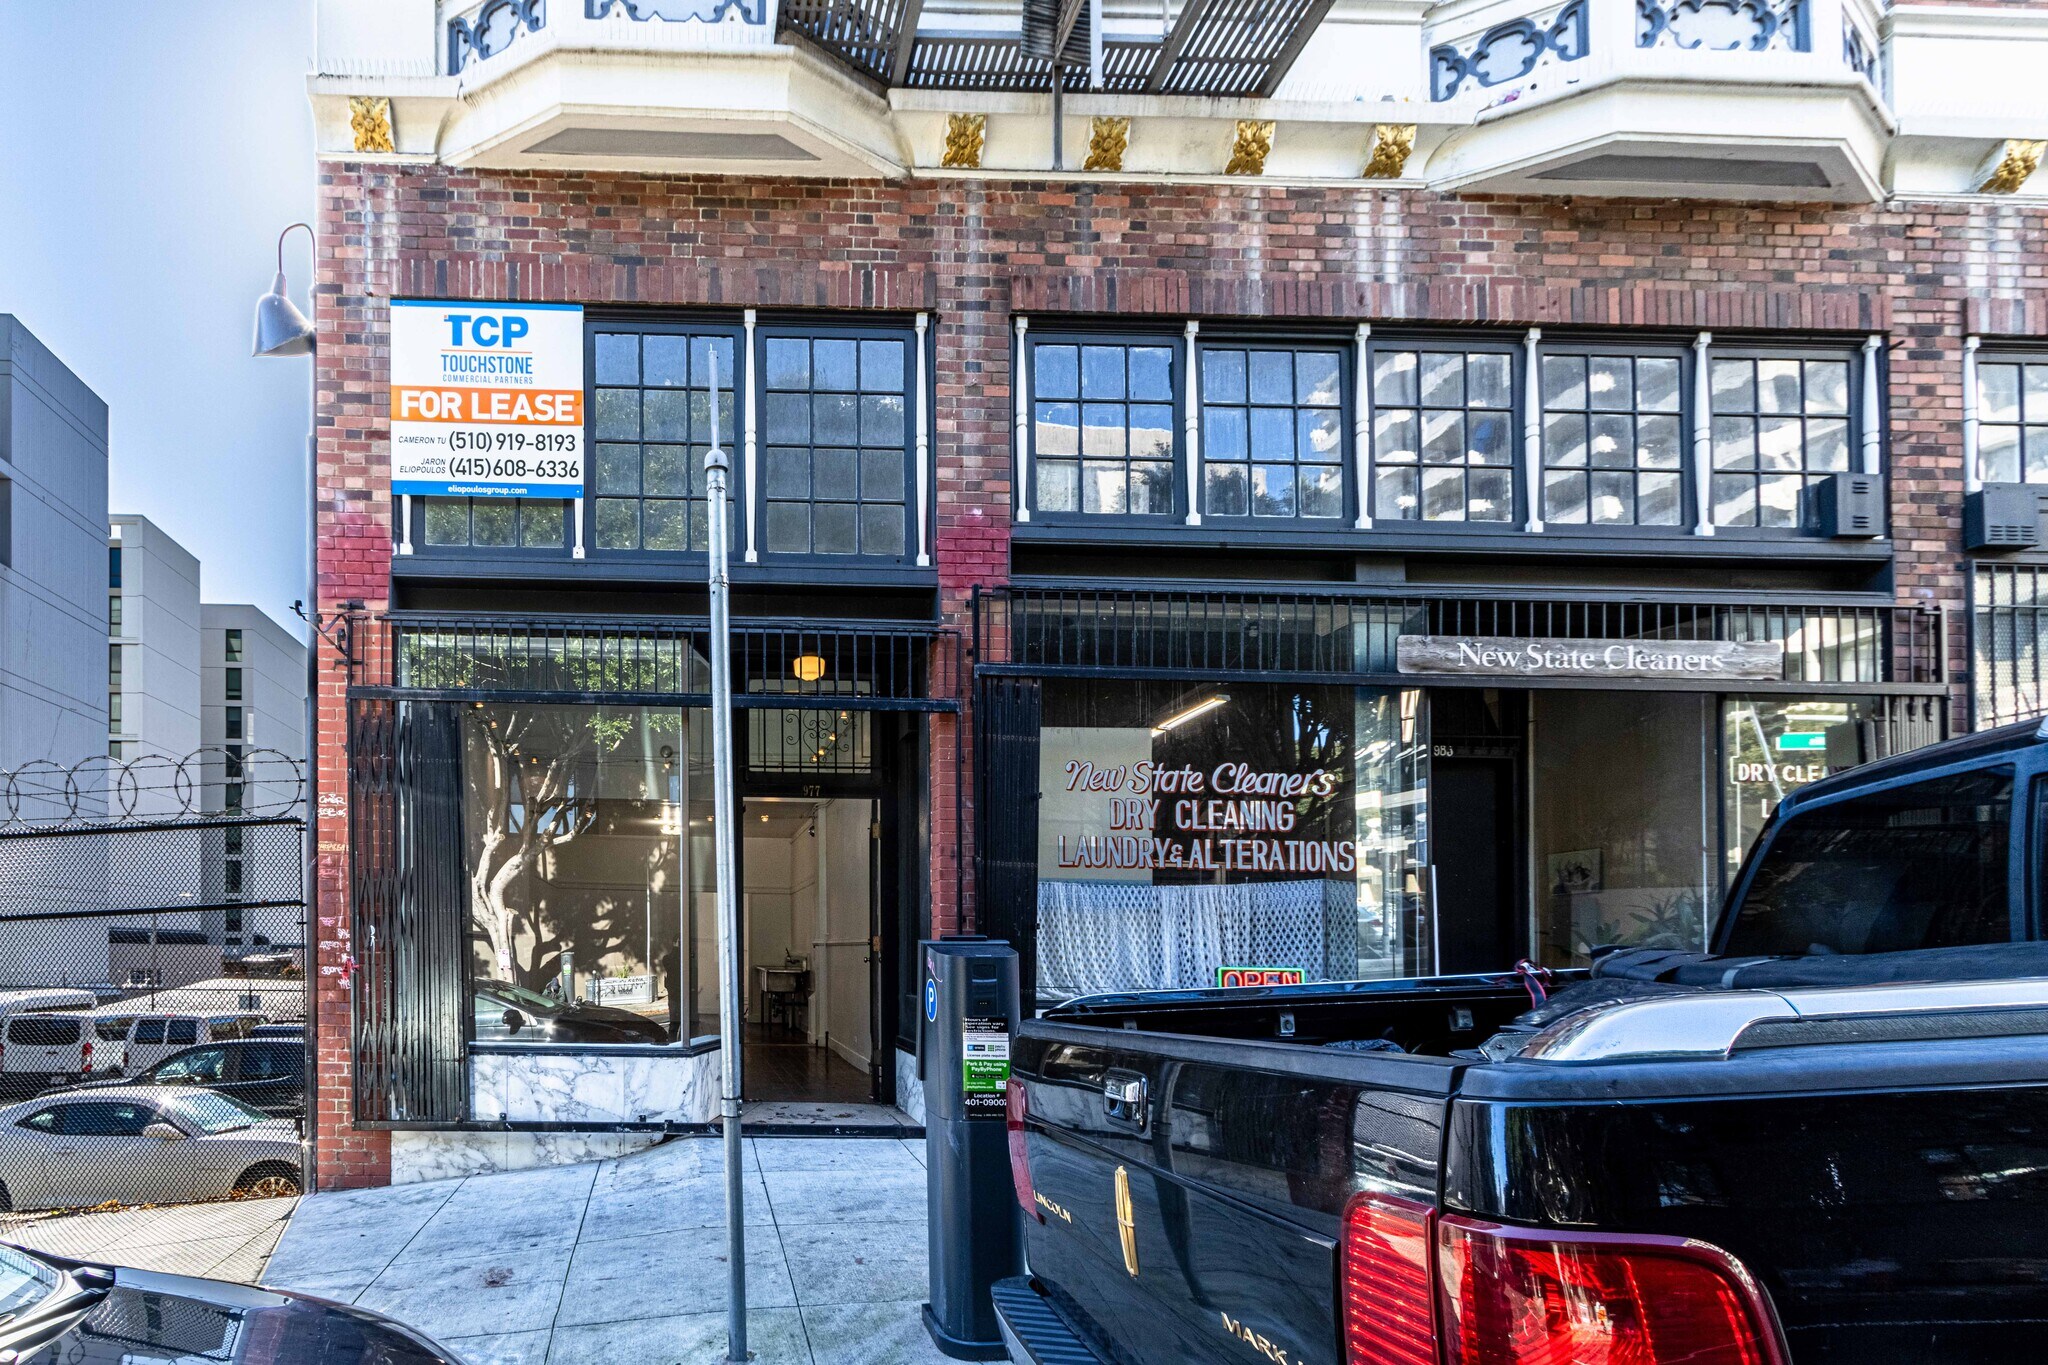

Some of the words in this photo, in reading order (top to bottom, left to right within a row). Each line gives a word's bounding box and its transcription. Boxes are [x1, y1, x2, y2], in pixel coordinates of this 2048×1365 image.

[444, 314, 529, 348] TCP
[441, 354, 533, 375] TOUCHSTONE
[442, 374, 492, 385] COMMERCIAL
[494, 375, 534, 385] PARTNERS
[401, 390, 462, 420] FOR
[471, 392, 575, 422] LEASE
[398, 435, 436, 444] CAMERON
[437, 436, 447, 444] TU
[449, 431, 492, 452] (510)
[496, 432, 576, 452] 919-8193
[399, 465, 447, 474] ELIOPOULOS
[420, 457, 447, 466] JARON
[447, 484, 528, 496] eliopoulosgroup.com
[1458, 641, 1522, 668] New
[1526, 643, 1595, 670] State
[1603, 645, 1724, 672] Cleaners
[1064, 760, 1126, 792] New
[1127, 760, 1204, 794] State
[1211, 762, 1335, 798] Cleaners
[1738, 763, 1778, 782] DRY
[803, 784, 821, 797] 977
[1109, 798, 1160, 831] DRY
[1174, 800, 1297, 833] CLEANING
[1188, 838, 1357, 874] ALTERATIONS
[1223, 970, 1301, 988] OPEN
[1033, 1189, 1072, 1224] LINCOLN
[1220, 1311, 1288, 1365] MARK
